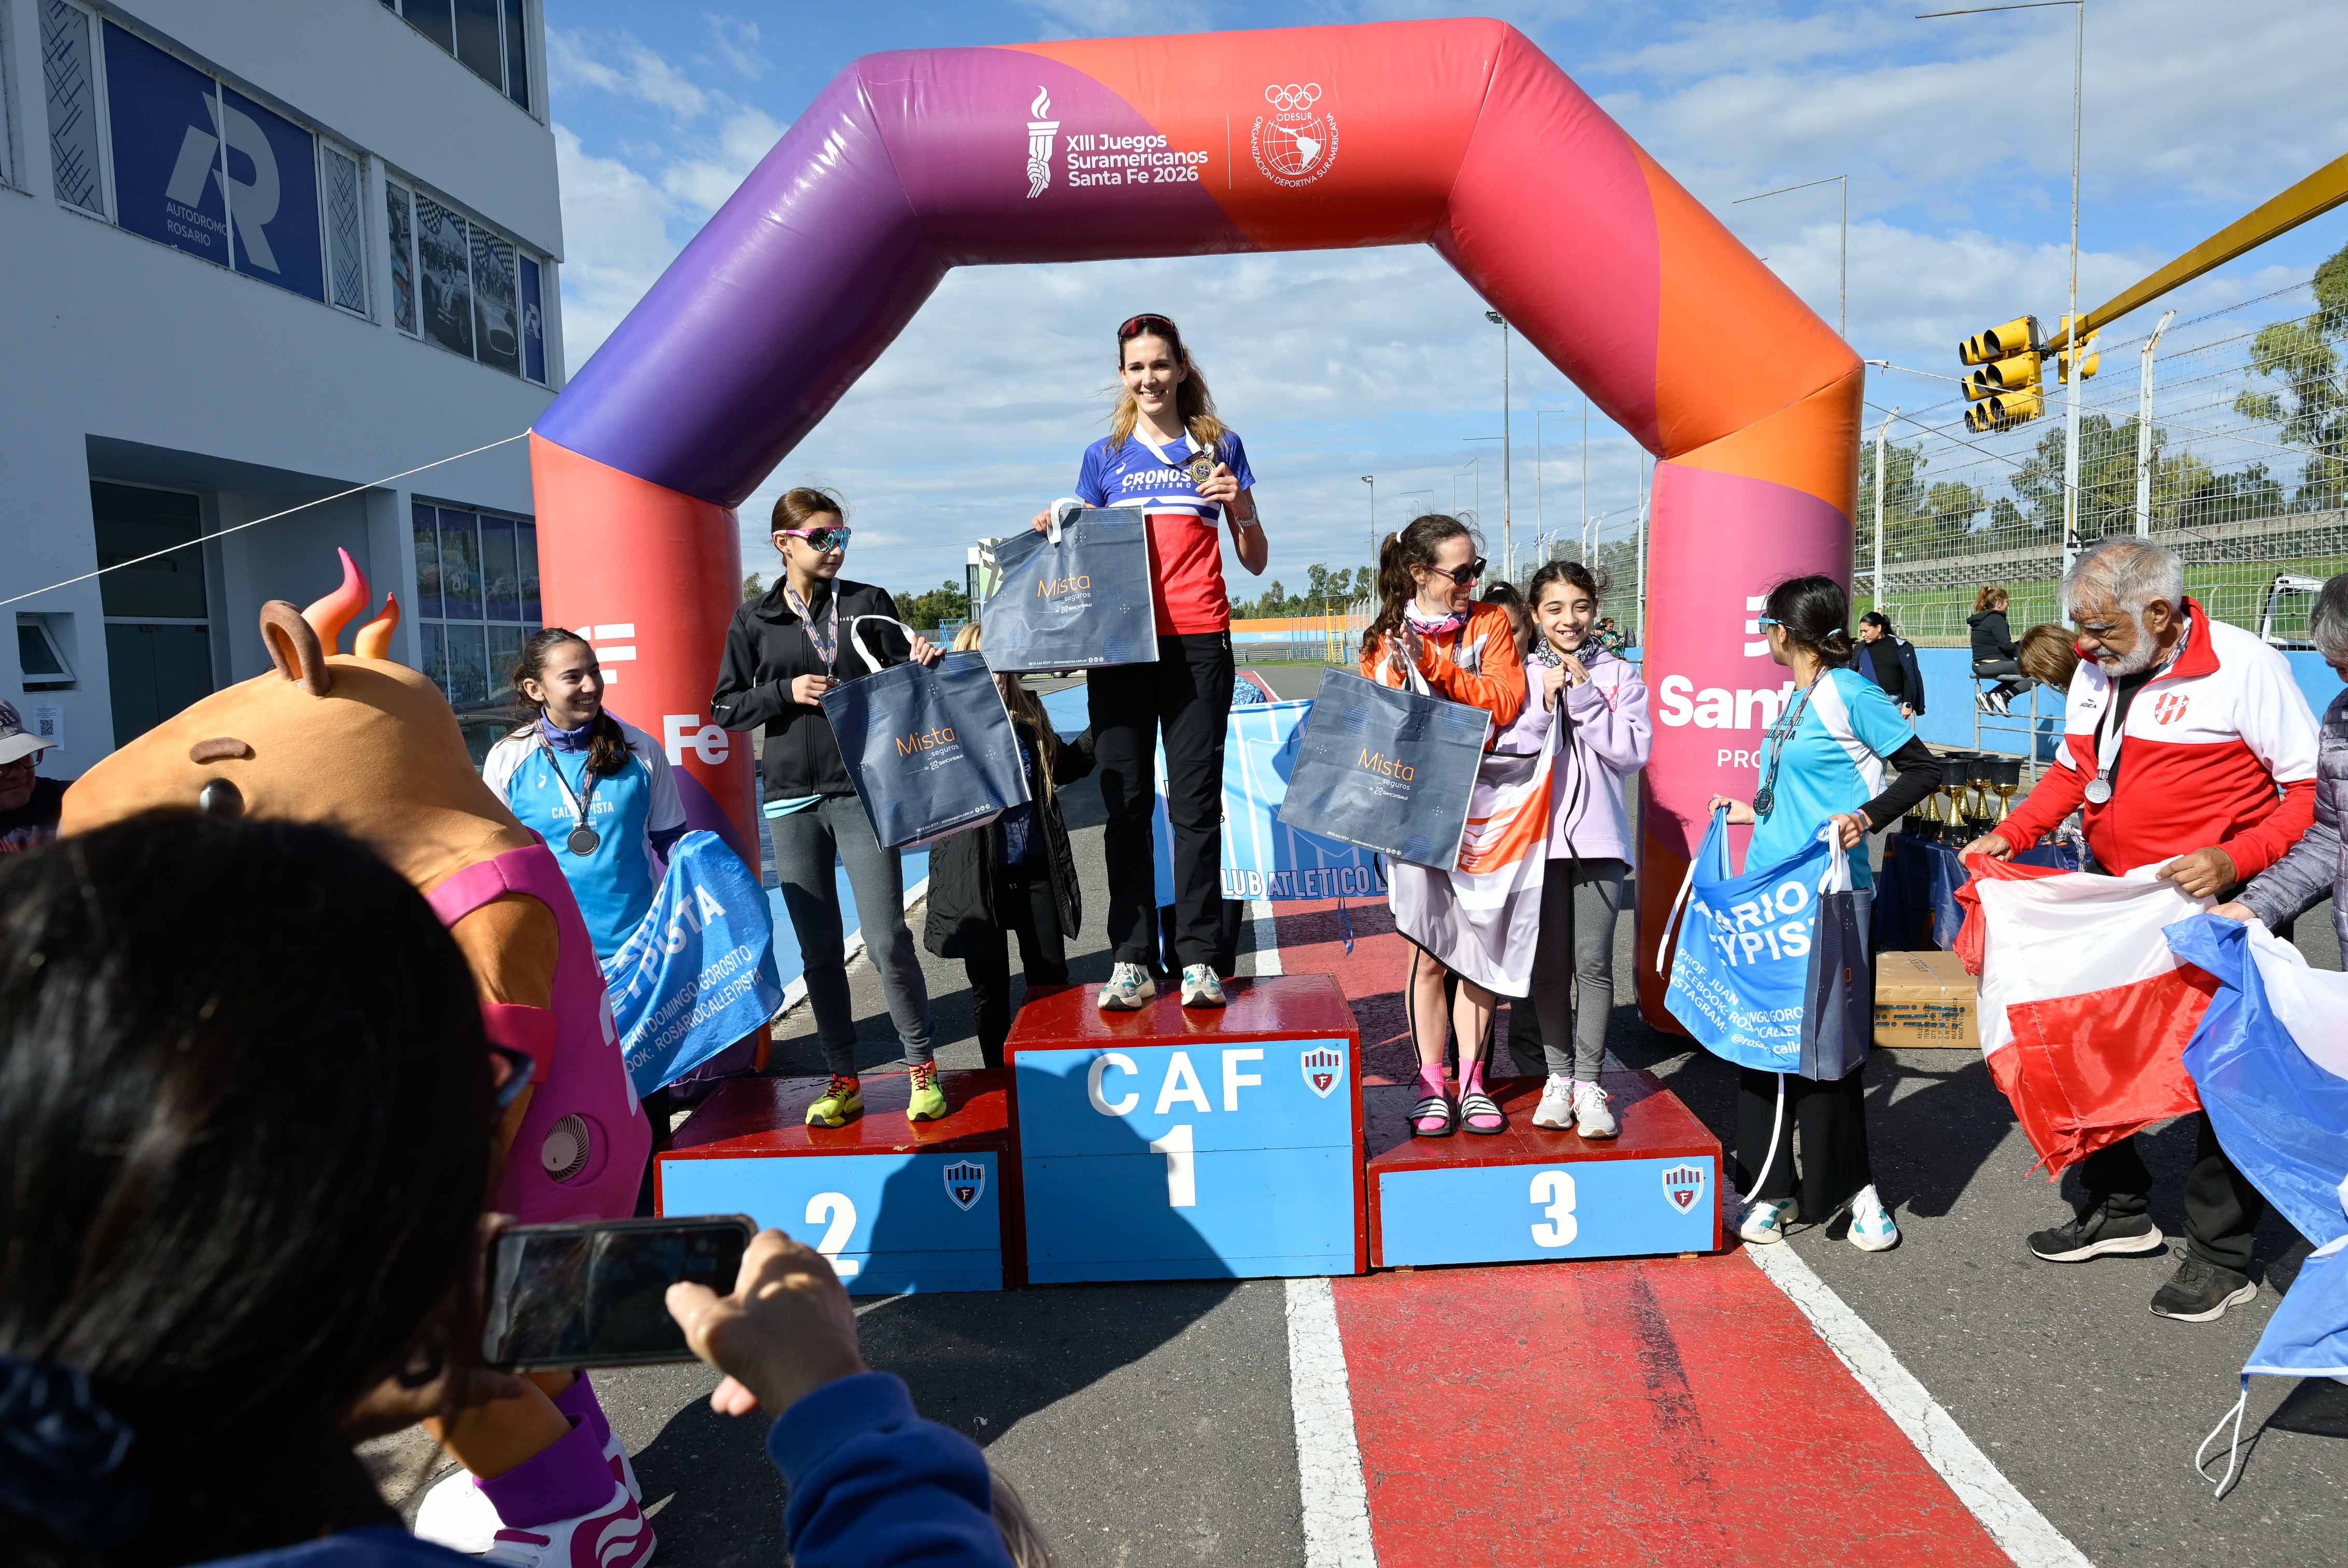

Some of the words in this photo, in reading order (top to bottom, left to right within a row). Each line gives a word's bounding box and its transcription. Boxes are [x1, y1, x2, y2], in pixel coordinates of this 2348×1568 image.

[1276, 112, 1312, 121] ODESUR
[1066, 134, 1095, 151] XIII
[1099, 134, 1167, 152] Juegos
[1251, 116, 1275, 181] ORGANIZACION
[1274, 175, 1318, 188] DEPORTIVA
[1317, 111, 1339, 178] SURAMERICANA
[1067, 148, 1208, 170] Suramericanos
[1068, 170, 1122, 187] Santa
[1127, 169, 1149, 184] Fe
[1153, 165, 1199, 183] 2026
[167, 219, 211, 246] ROSARIO
[1121, 482, 1191, 493] ATLETISMO
[1122, 469, 1192, 487] CRONOS
[1037, 572, 1091, 598] Mista
[1064, 592, 1091, 602] seguros
[663, 714, 729, 766] Fe
[896, 727, 956, 757] Mista
[931, 744, 959, 757] seguros
[1358, 748, 1415, 781] Mista
[1382, 779, 1410, 791] seguros
[1220, 869, 1262, 896] LUB
[1267, 865, 1370, 897] ATLETICO
[646, 982, 698, 1033] DOMINGO
[697, 945, 752, 990] GOROSITO
[1672, 960, 1729, 1016] FACEBOOK:
[1677, 948, 1708, 980] PROF.
[1709, 978, 1739, 1006] JUAN
[1770, 1006, 1806, 1023] GORO
[654, 967, 763, 1052] ROSARIOCALLEYPISTA
[1088, 1048, 1264, 1116] CAF
[1150, 1124, 1196, 1207] 1
[1529, 1170, 1578, 1248] 3
[805, 1192, 859, 1276] 2
